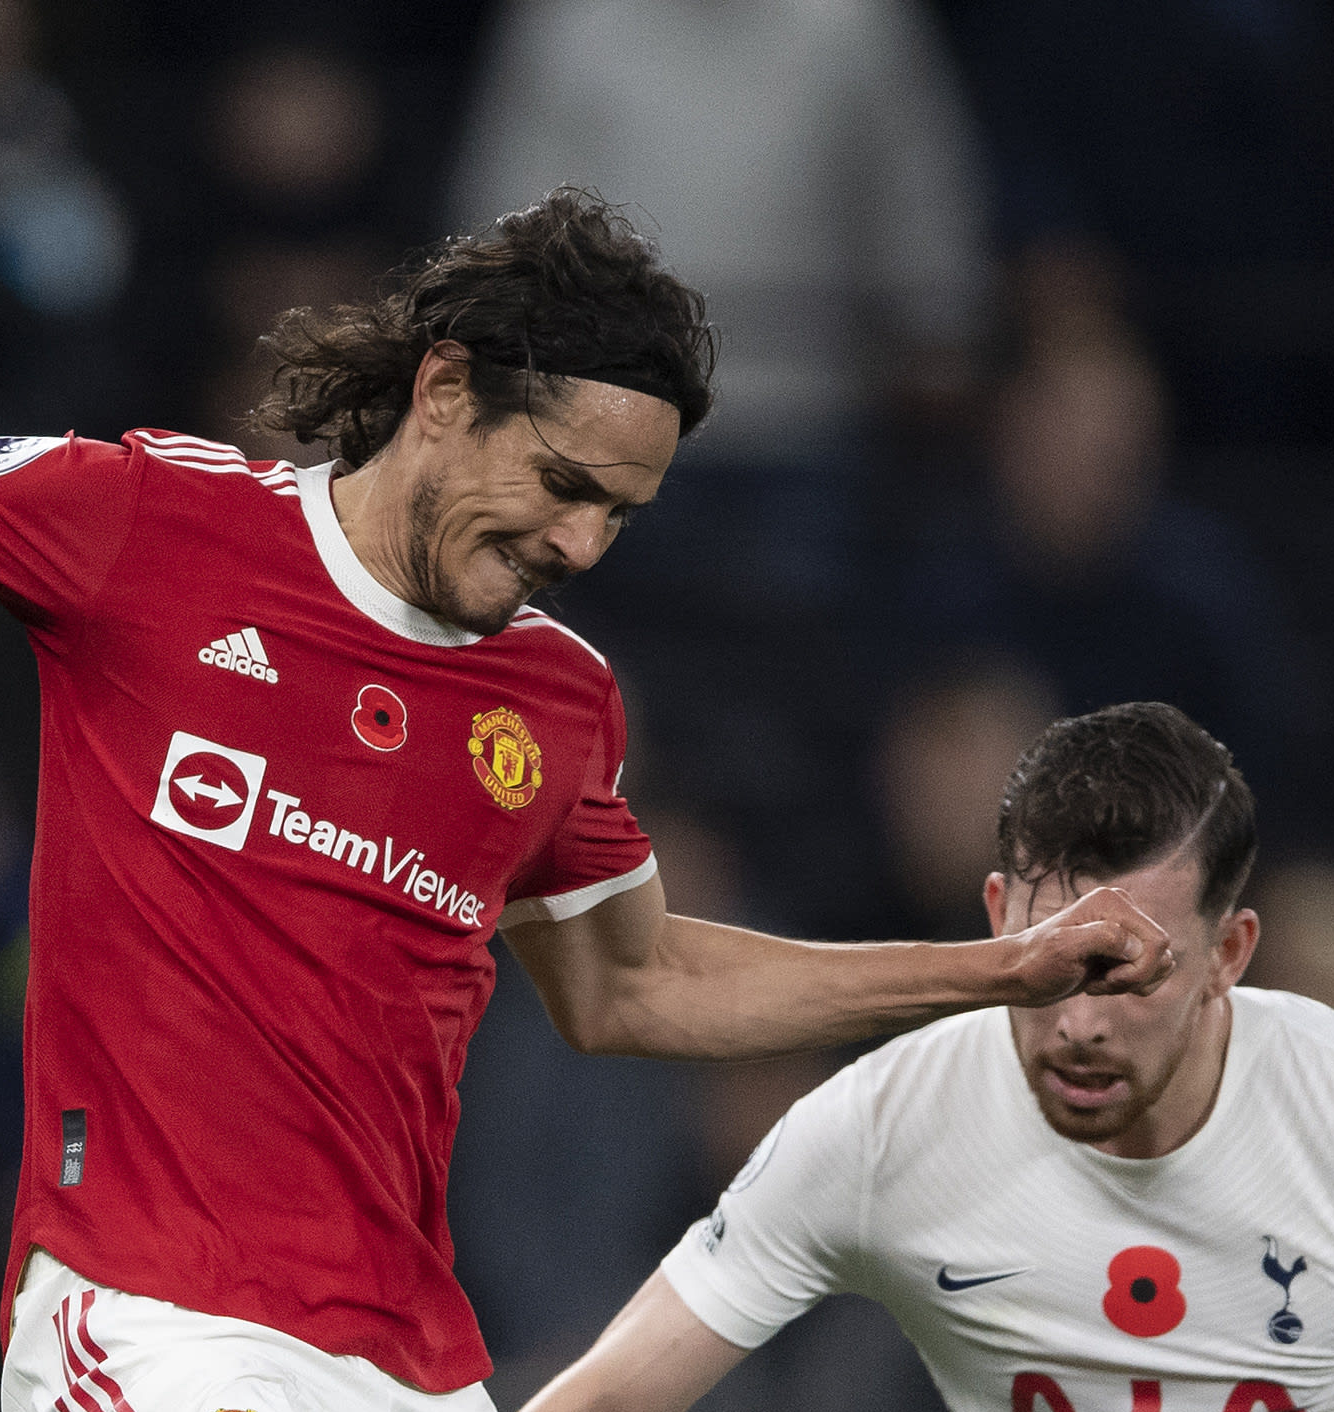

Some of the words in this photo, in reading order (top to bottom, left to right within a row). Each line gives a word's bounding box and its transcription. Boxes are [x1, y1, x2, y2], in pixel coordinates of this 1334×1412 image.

[198, 648, 279, 684] adidas
[477, 714, 537, 760] MANCHESTER
[485, 775, 525, 803] UNITED
